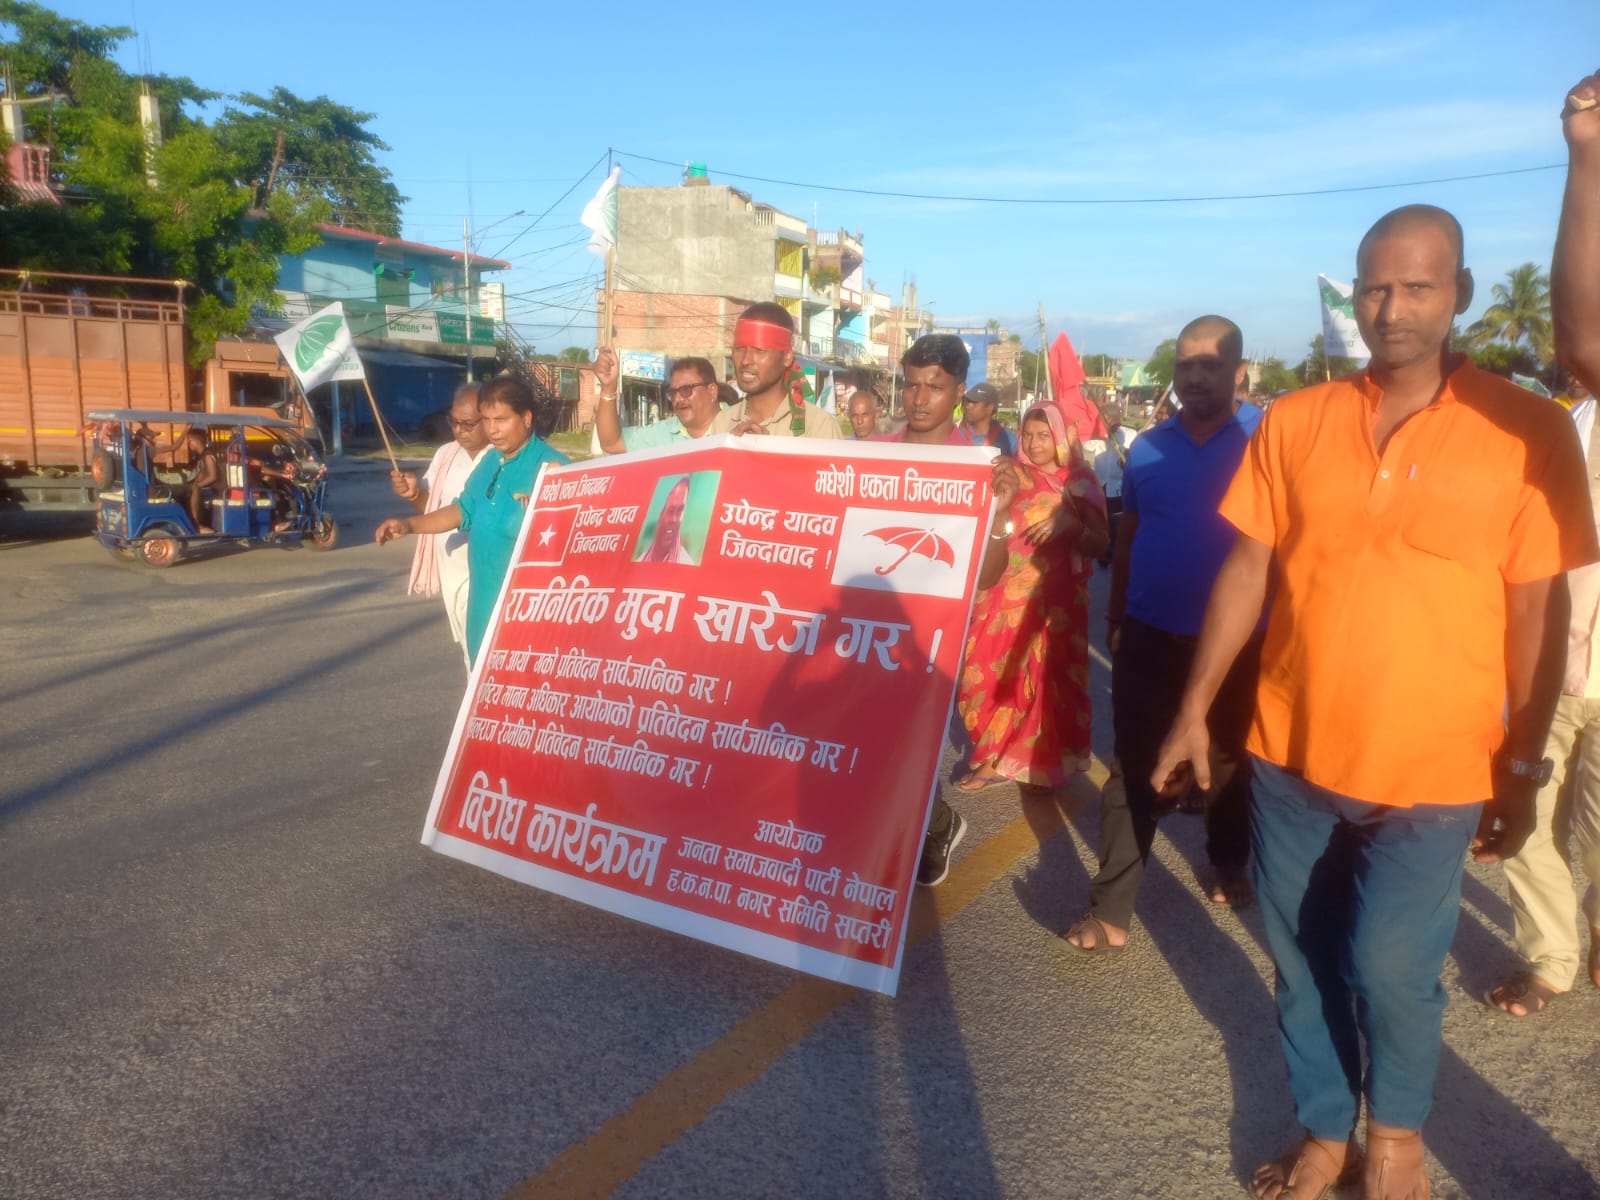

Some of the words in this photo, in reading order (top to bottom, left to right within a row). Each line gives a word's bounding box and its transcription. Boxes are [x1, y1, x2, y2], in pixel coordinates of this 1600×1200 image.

[389, 323, 420, 334] Citizens
[815, 463, 855, 498] मधेशी
[859, 472, 900, 501] एकता
[904, 467, 976, 507] जिन्दावाद
[980, 481, 987, 507] !
[577, 506, 607, 529] उपेन्द्र
[607, 505, 639, 525] यादव
[720, 498, 779, 531] उपेन्द्र
[783, 511, 839, 536] यादव
[570, 532, 622, 554] जिन्दावाद
[719, 529, 818, 569] जिन्दावाद
[825, 549, 833, 570] !
[504, 574, 616, 626] राजनितिक
[614, 587, 686, 641] मुदा
[693, 590, 826, 656] खारेज
[834, 616, 911, 671] गर
[926, 628, 943, 674] !
[554, 647, 603, 681] प्रतिवेदन
[688, 673, 720, 704] गर
[723, 680, 732, 705] !
[501, 685, 530, 709] मानव
[527, 681, 571, 718] अधिकार
[569, 689, 635, 728] आयोगको
[637, 700, 710, 743] प्रतिवेदन
[811, 739, 846, 773] गर
[849, 747, 858, 774] !
[533, 721, 583, 760] प्रतिवेदन
[669, 757, 702, 787] गर
[702, 764, 712, 790] !
[458, 770, 528, 846] विरोध
[526, 803, 668, 886] कार्यक्रम
[754, 819, 827, 854] आयोजक
[678, 836, 722, 865] जनता
[724, 847, 803, 887] समाजवादी
[804, 866, 842, 897] पार्टी
[843, 871, 898, 912] नेपाल
[737, 886, 776, 918] नगर
[778, 895, 831, 933] समिति
[834, 913, 893, 949] सप्तरी
